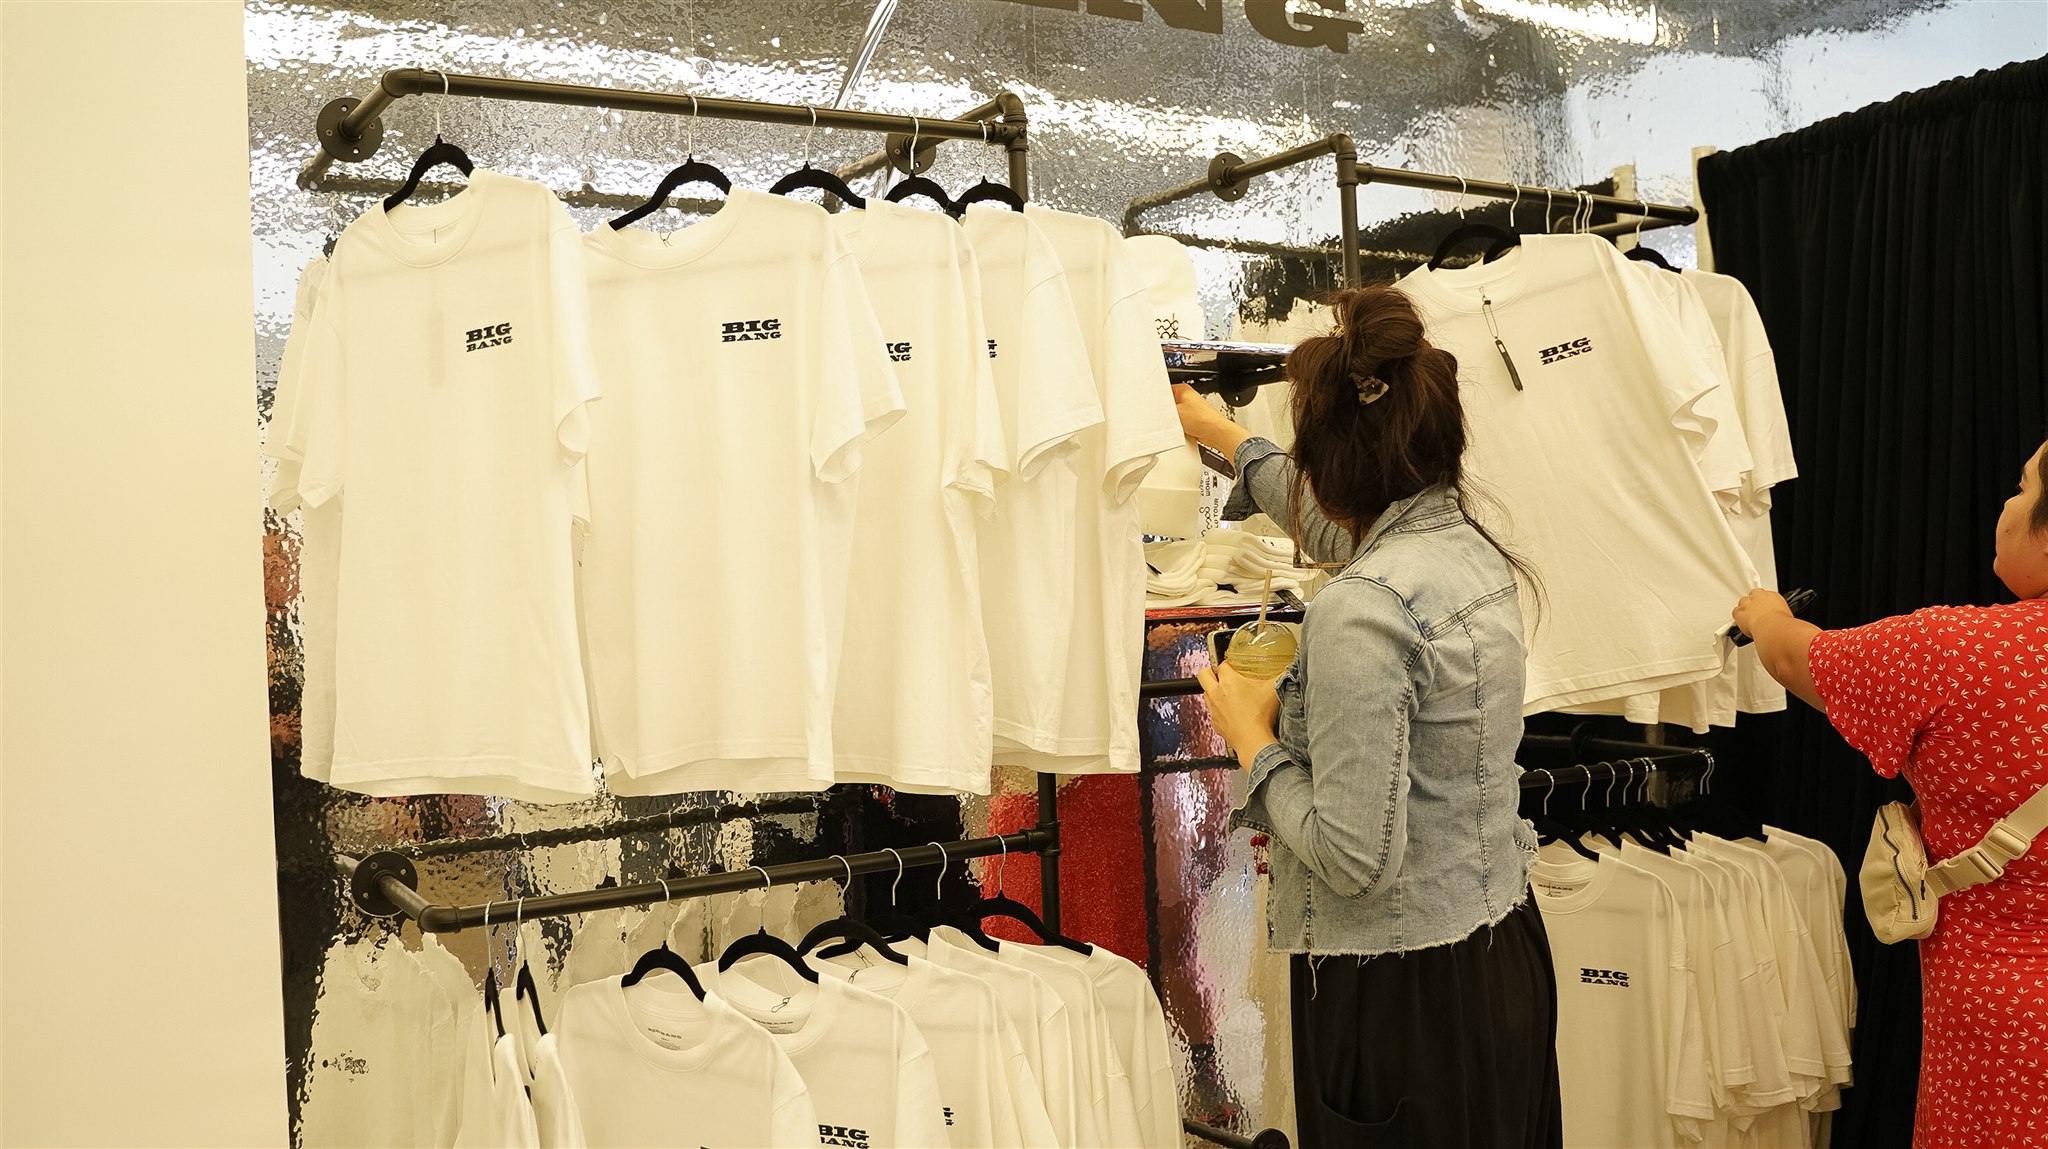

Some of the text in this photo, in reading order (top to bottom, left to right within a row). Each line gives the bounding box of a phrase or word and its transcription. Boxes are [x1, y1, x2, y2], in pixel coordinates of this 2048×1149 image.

[466, 322, 512, 343] BIG
[722, 319, 781, 333] BIG
[466, 336, 513, 352] BANG
[722, 332, 781, 342] BANG
[886, 342, 911, 353] IG
[1539, 337, 1591, 359] BIG
[1541, 346, 1593, 365] BANG
[1580, 968, 1629, 981] BIG
[1580, 977, 1629, 987] BANG
[818, 1124, 869, 1141] BIG
